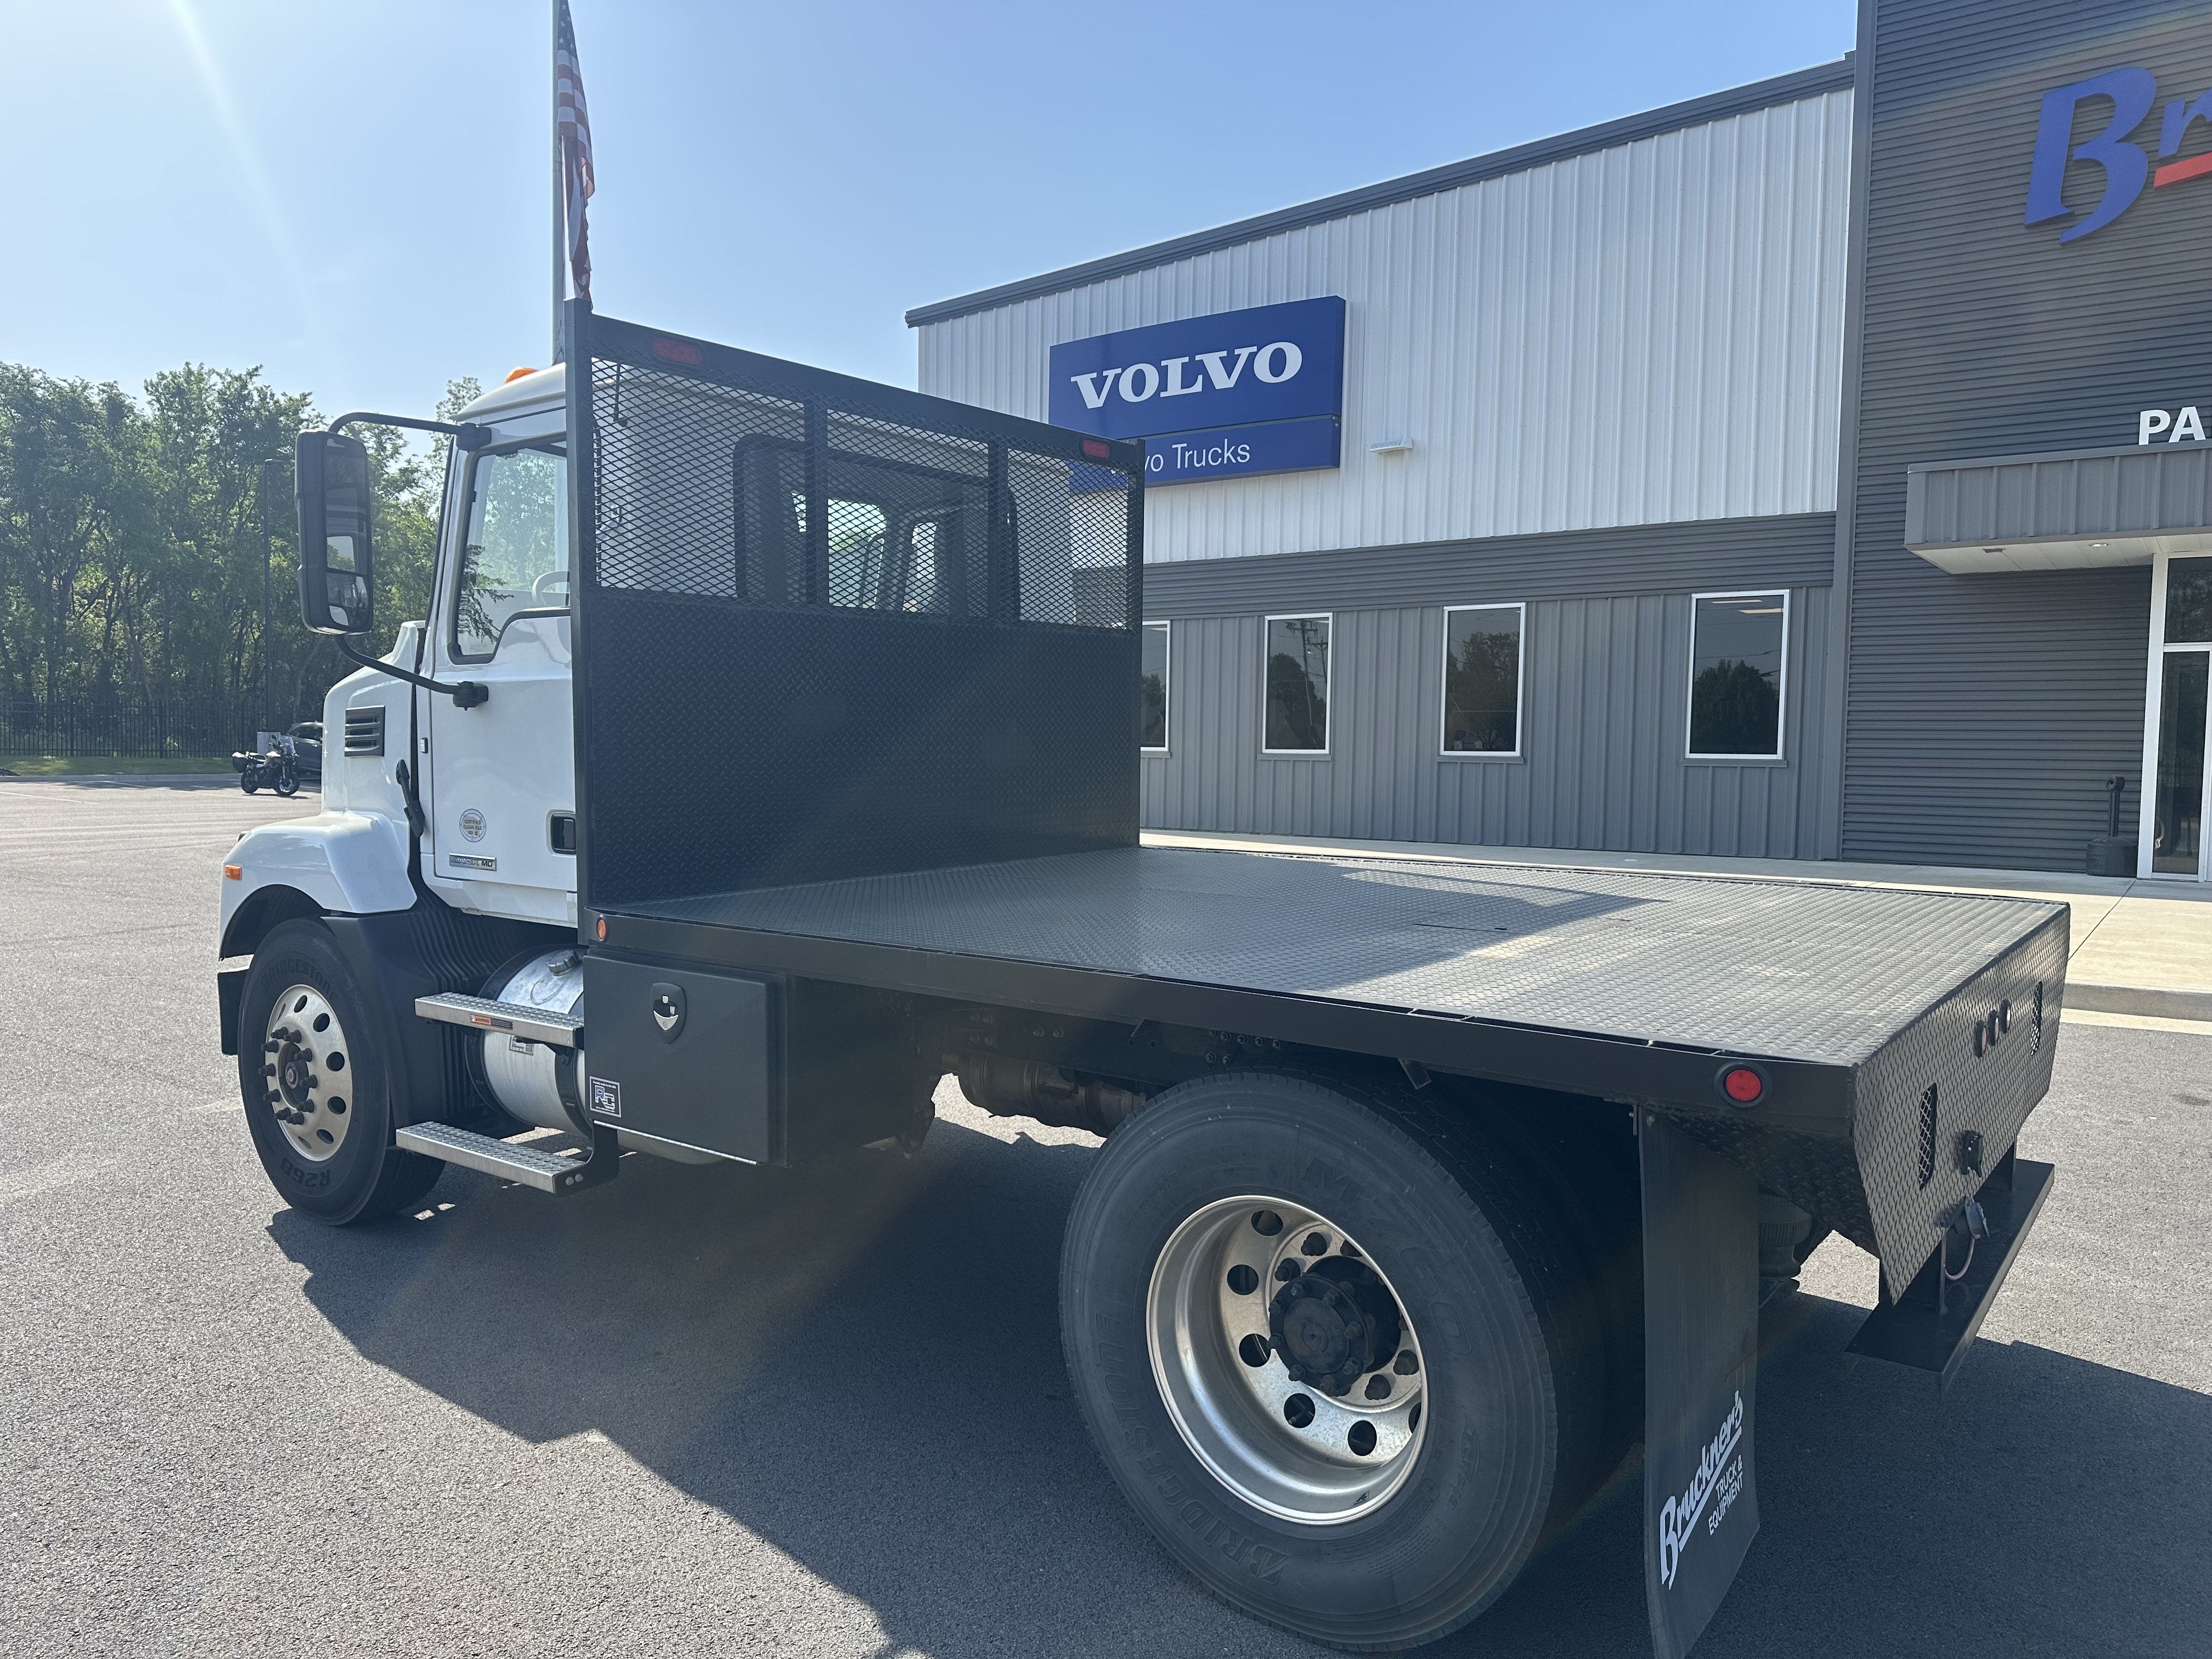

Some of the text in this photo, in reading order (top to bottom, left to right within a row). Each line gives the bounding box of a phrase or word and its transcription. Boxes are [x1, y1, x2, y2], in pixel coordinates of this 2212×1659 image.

[1071, 341, 1302, 409] VOLVO
[1172, 439, 1251, 469] Trucks
[450, 856, 479, 866] MACK
[1660, 1390, 1743, 1590] Bruckner's
[1708, 1471, 1743, 1536] EQUIPMENT
[1716, 1454, 1743, 1501] TRUCK &
